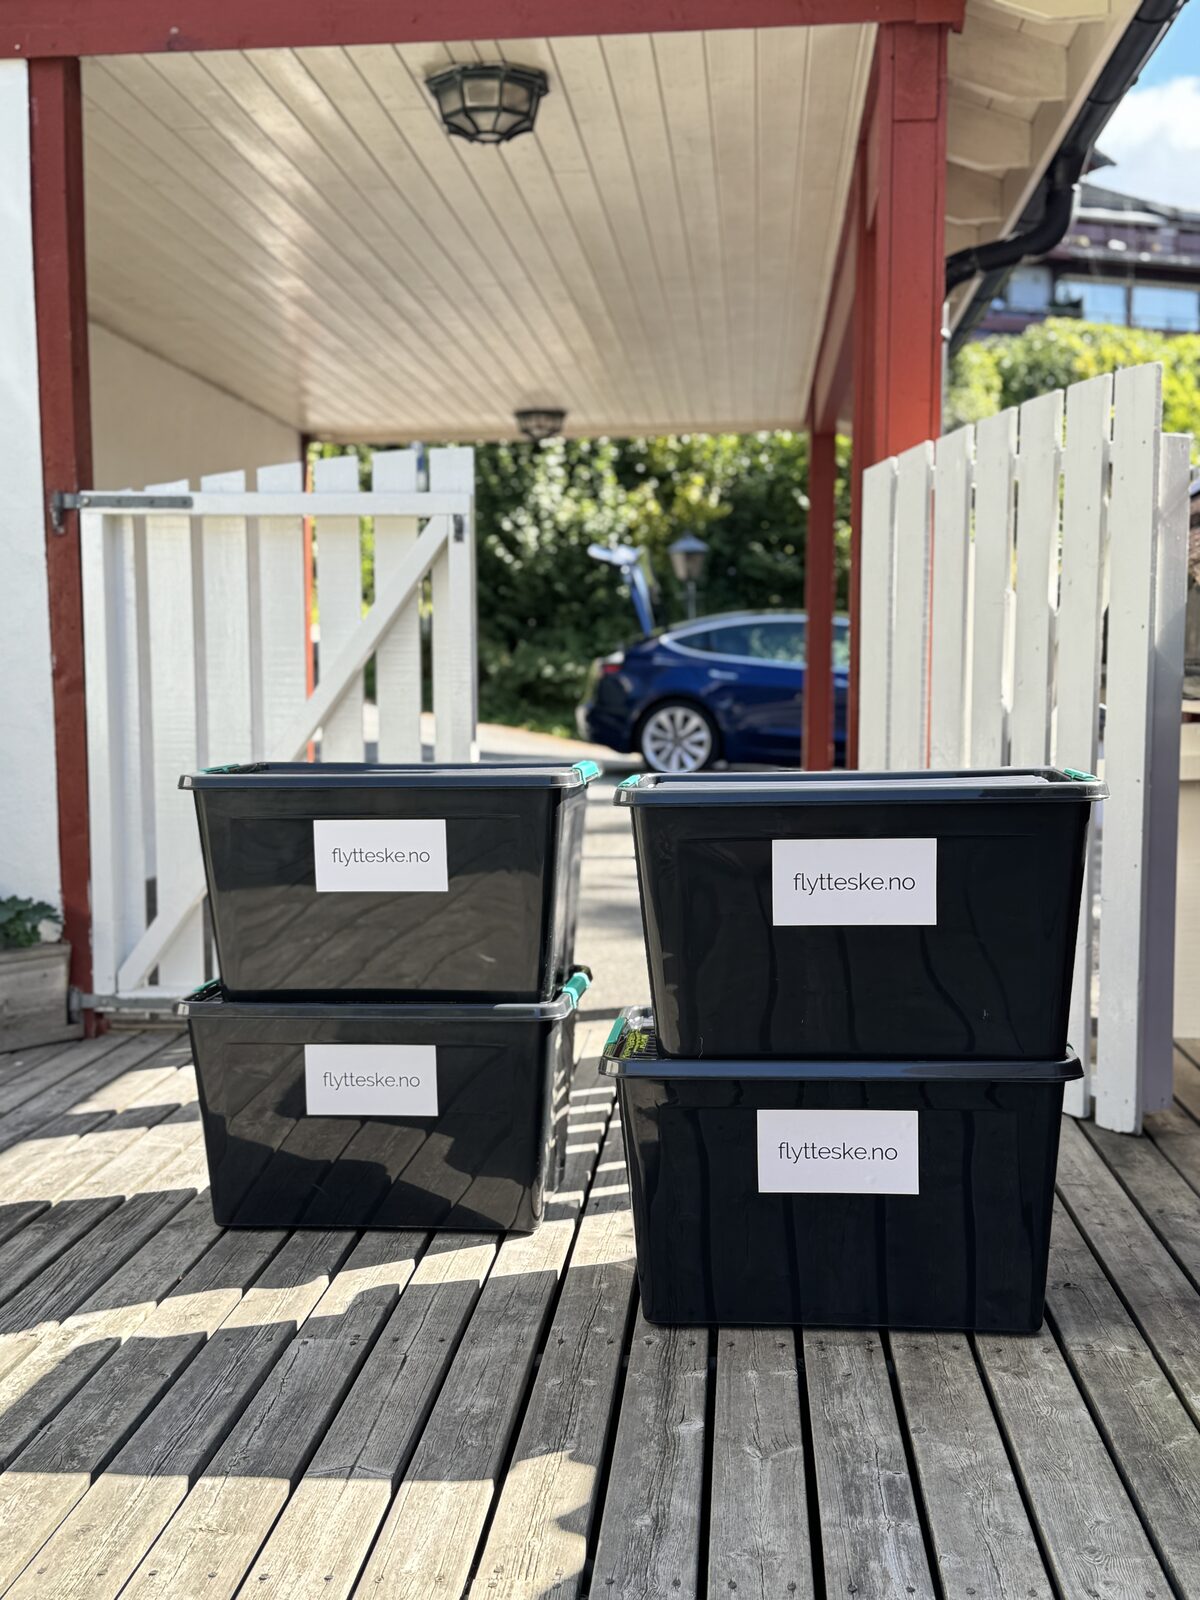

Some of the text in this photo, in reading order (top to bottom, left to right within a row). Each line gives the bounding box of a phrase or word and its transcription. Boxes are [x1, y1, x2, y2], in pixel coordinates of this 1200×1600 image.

[332, 847, 431, 866] flytteske.no
[792, 872, 916, 895] flytteske.no
[322, 1071, 421, 1090] flytteske.no
[777, 1141, 898, 1164] flytteske.no
